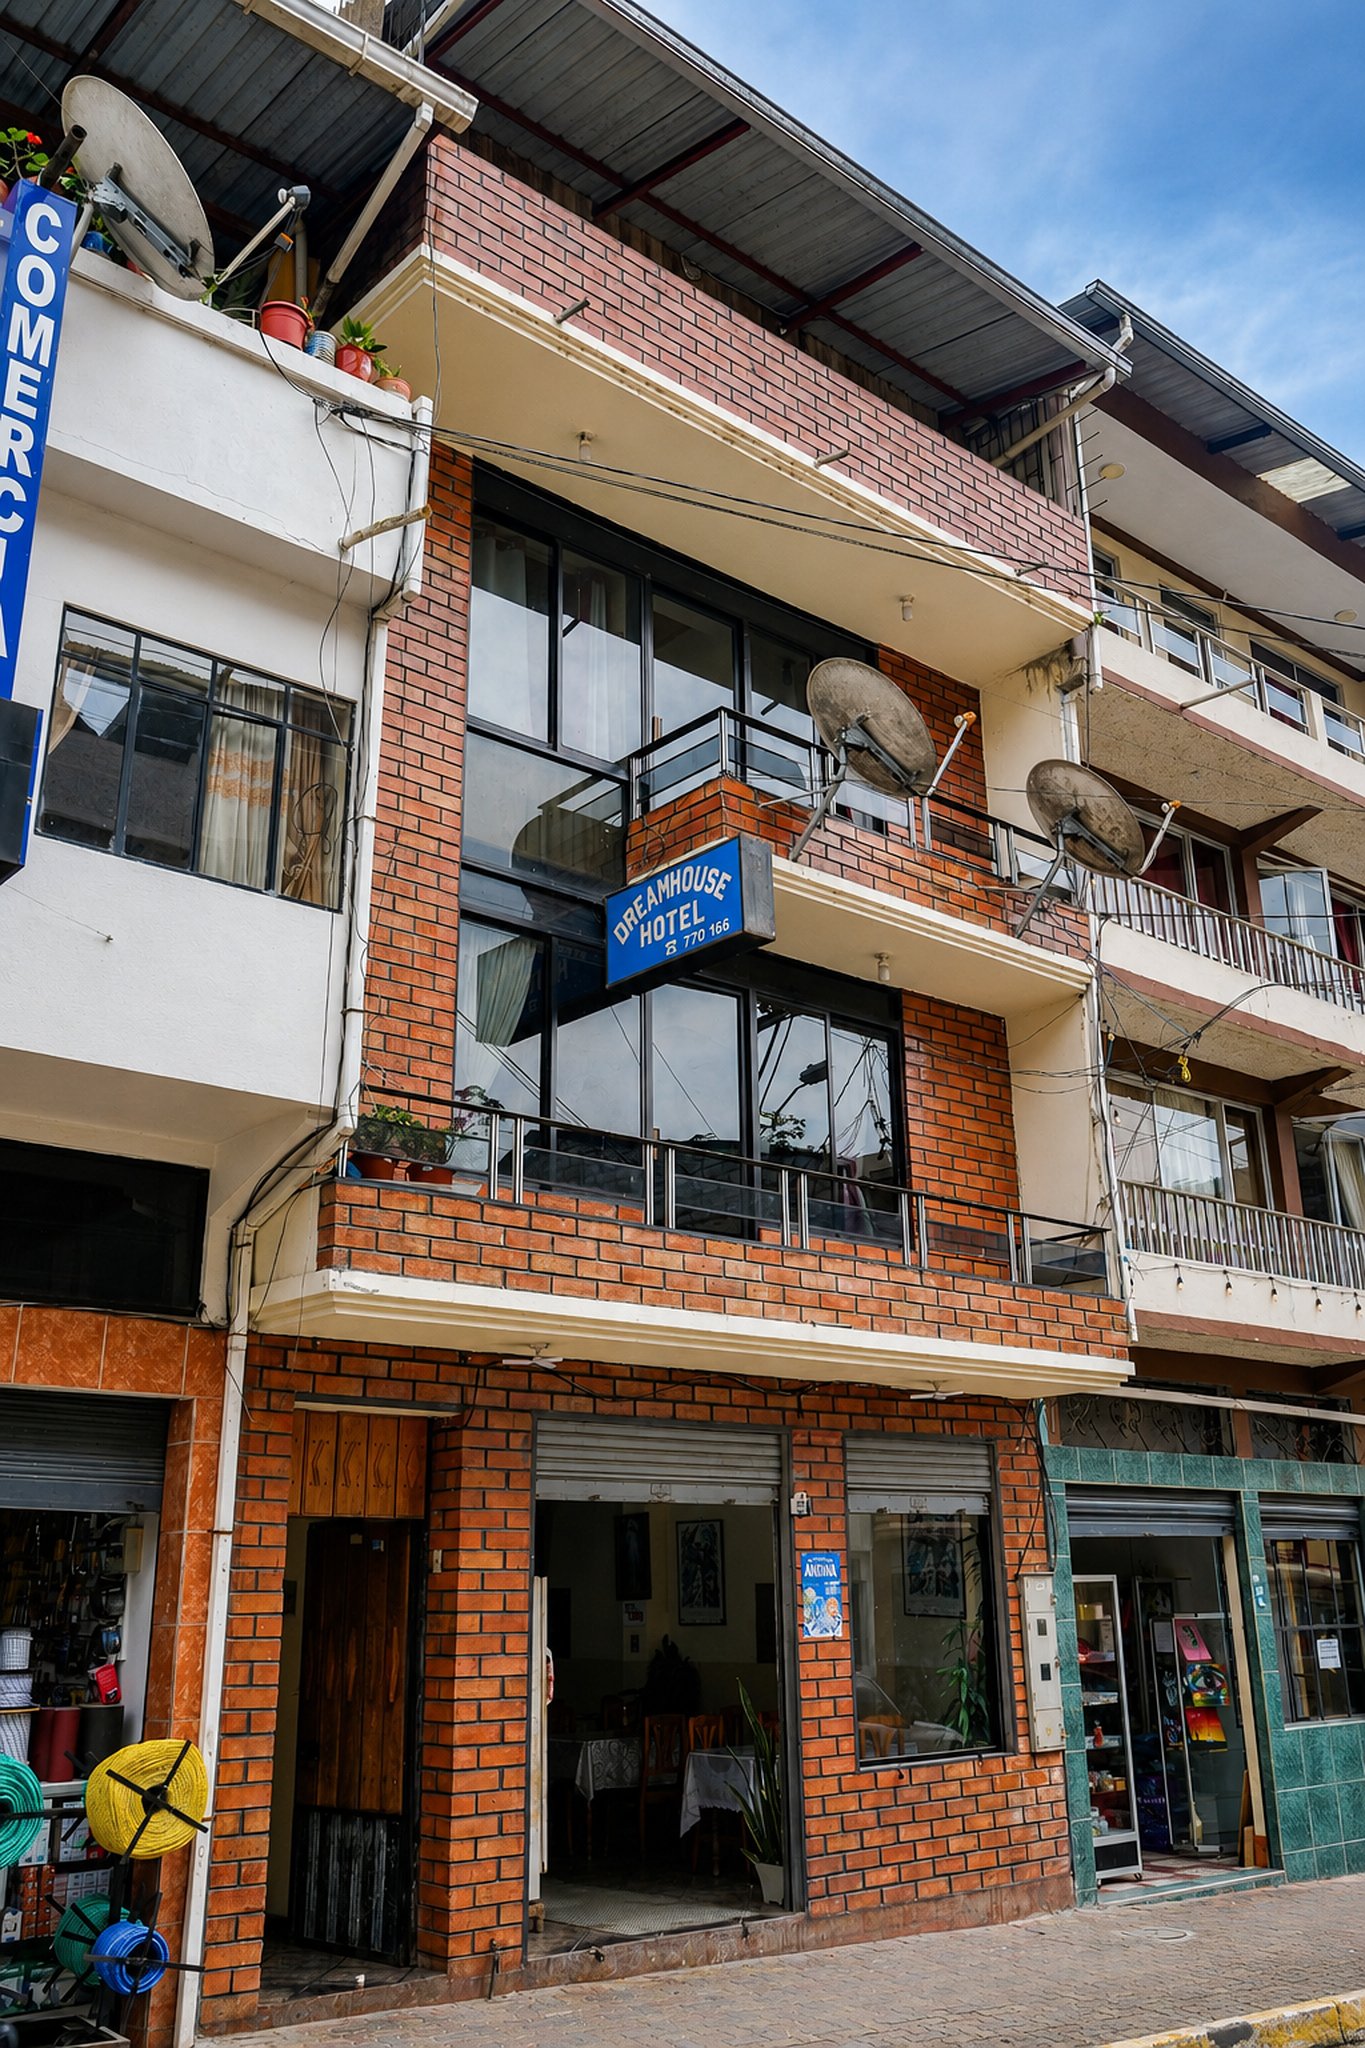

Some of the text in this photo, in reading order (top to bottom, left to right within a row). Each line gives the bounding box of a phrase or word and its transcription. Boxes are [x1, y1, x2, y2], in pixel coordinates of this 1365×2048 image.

[613, 865, 732, 946] DREAMHOUSE
[640, 900, 706, 948] HOTEL
[684, 918, 730, 948] 770 166
